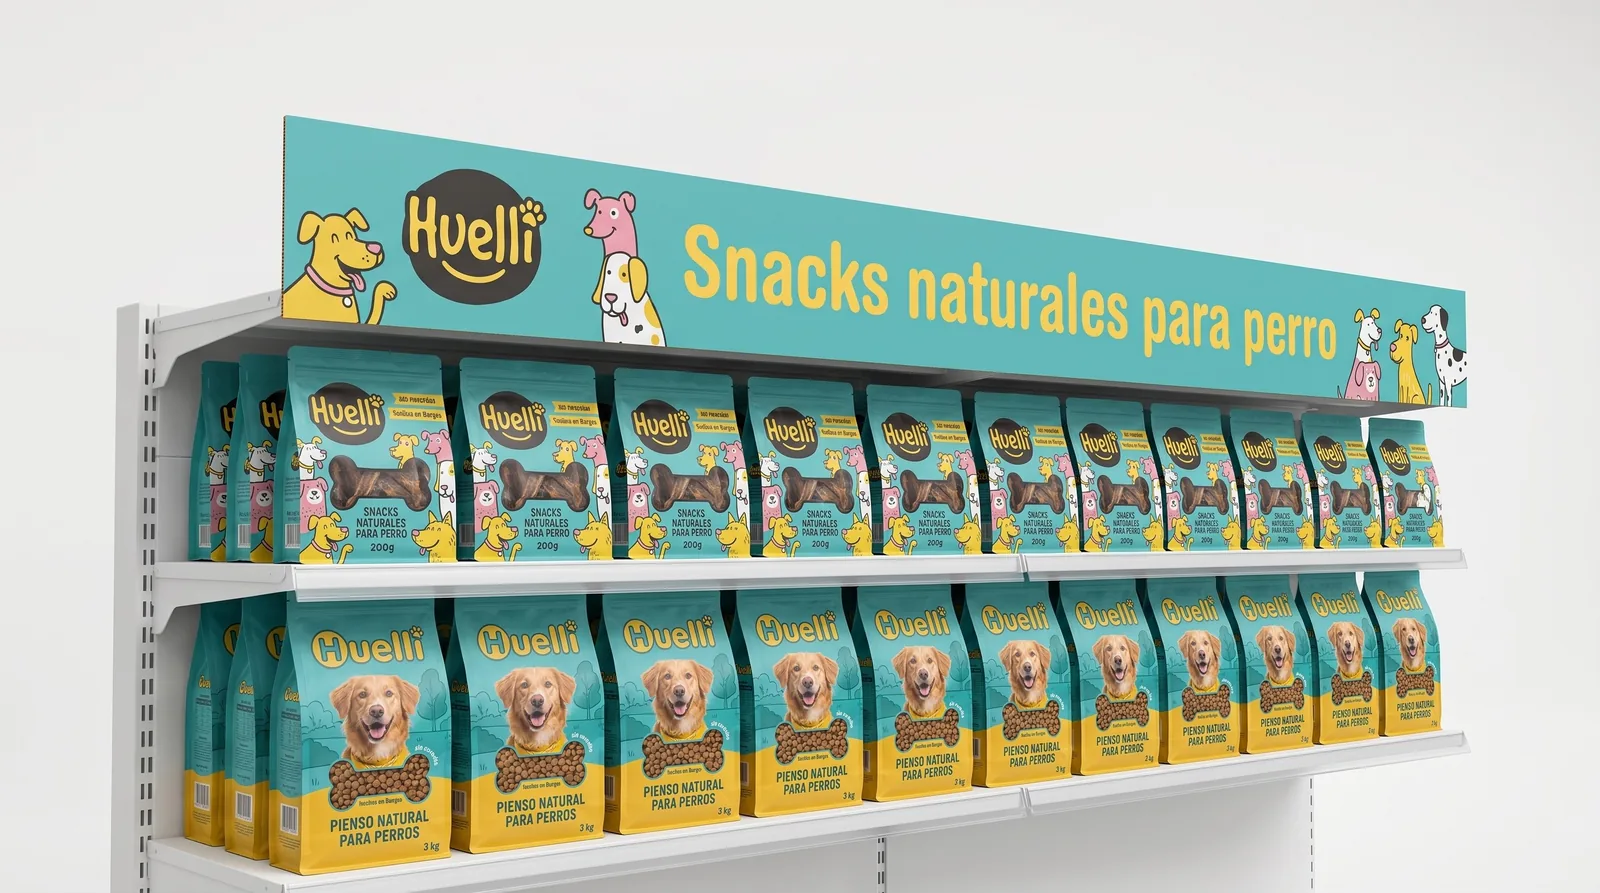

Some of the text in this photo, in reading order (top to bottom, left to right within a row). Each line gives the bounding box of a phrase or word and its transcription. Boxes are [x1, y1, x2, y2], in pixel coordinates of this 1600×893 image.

[409, 195, 547, 265] Huelli
[684, 223, 1337, 366] Snacks naturales para perro
[312, 394, 384, 425] Huelli
[481, 402, 545, 432] Huelli
[633, 410, 690, 437] Huelli
[765, 416, 816, 442] Huelli
[883, 422, 928, 447] Huelli
[990, 427, 1030, 449] Huelli
[1080, 432, 1118, 454] Huelli
[1163, 436, 1199, 456] Huelli
[1243, 439, 1274, 459] Huelli
[1315, 443, 1345, 462] Huelli
[1382, 448, 1408, 465] Huelli
[364, 507, 398, 516] SNACKS
[530, 508, 561, 517] SNACKS
[677, 509, 705, 517] SNACKS
[807, 510, 832, 518] SNACKS
[356, 518, 406, 527] NATURALES
[524, 519, 569, 527] NATURALES
[672, 519, 711, 527] NATURALES
[802, 519, 838, 527] NATURALES
[919, 519, 950, 527] NATURALES
[1024, 519, 1052, 527] NATURALES
[356, 529, 407, 538] PARA PERRO
[524, 529, 570, 537] PARA PERRO
[672, 529, 712, 537] PARA PERRO
[802, 528, 818, 536] PARA
[1038, 527, 1053, 535] PERRO
[537, 542, 558, 551] 200g
[683, 541, 701, 550] 200g
[812, 540, 829, 548] 200g
[928, 539, 943, 547] 200g
[1032, 538, 1045, 546] 200g
[1202, 536, 1212, 544] 200g
[371, 543, 394, 553] 200g
[1239, 593, 1292, 621] Huelli
[1311, 591, 1360, 617] Huelli
[1376, 588, 1423, 614] Huelli
[1075, 600, 1139, 630] Huelli
[1161, 596, 1219, 625] Huelli
[875, 606, 950, 641] Huelli
[981, 602, 1049, 634] Huelli
[623, 616, 715, 653] Huelli
[756, 610, 839, 646] Huelli
[477, 619, 580, 660] Huelli
[311, 626, 424, 669] Huelli
[1333, 705, 1373, 718] PIENSO NATURAL
[1397, 699, 1435, 712] PIENSO NATURAL
[1261, 714, 1305, 728] PIENSO NATURAL
[1400, 711, 1413, 720] PARA
[1183, 722, 1231, 736] PIENSO NATURAL
[1337, 719, 1350, 728] PARA
[1266, 727, 1280, 737] PARA
[1097, 732, 1149, 747] PIENSO NATURAL
[1188, 734, 1226, 747] PARA PERROS
[1004, 742, 1060, 757] PIENSO NATURAL
[1102, 743, 1144, 757] PARA PERROS
[896, 753, 960, 769] PIENSO NATURAL
[1010, 754, 1056, 768] PARA PERROS
[776, 765, 847, 783] PIENSO NATURAL
[902, 766, 953, 781] PARA PERROS
[1061, 766, 1065, 774] kg
[644, 779, 724, 797] PIENSO NATURAL
[783, 779, 840, 795] PARA PERROS
[960, 778, 965, 786] kg
[652, 793, 715, 811] PARA PERROS
[848, 791, 855, 800] kg
[496, 793, 585, 813] PIENSO NATURAL
[505, 809, 577, 827] PARA PERROS
[718, 806, 731, 816] 3 kg
[330, 810, 429, 833] PIENSO NATURAL
[579, 822, 594, 833] 3 kg
[339, 827, 420, 847] PARA PERROS
[430, 841, 440, 852] kg
